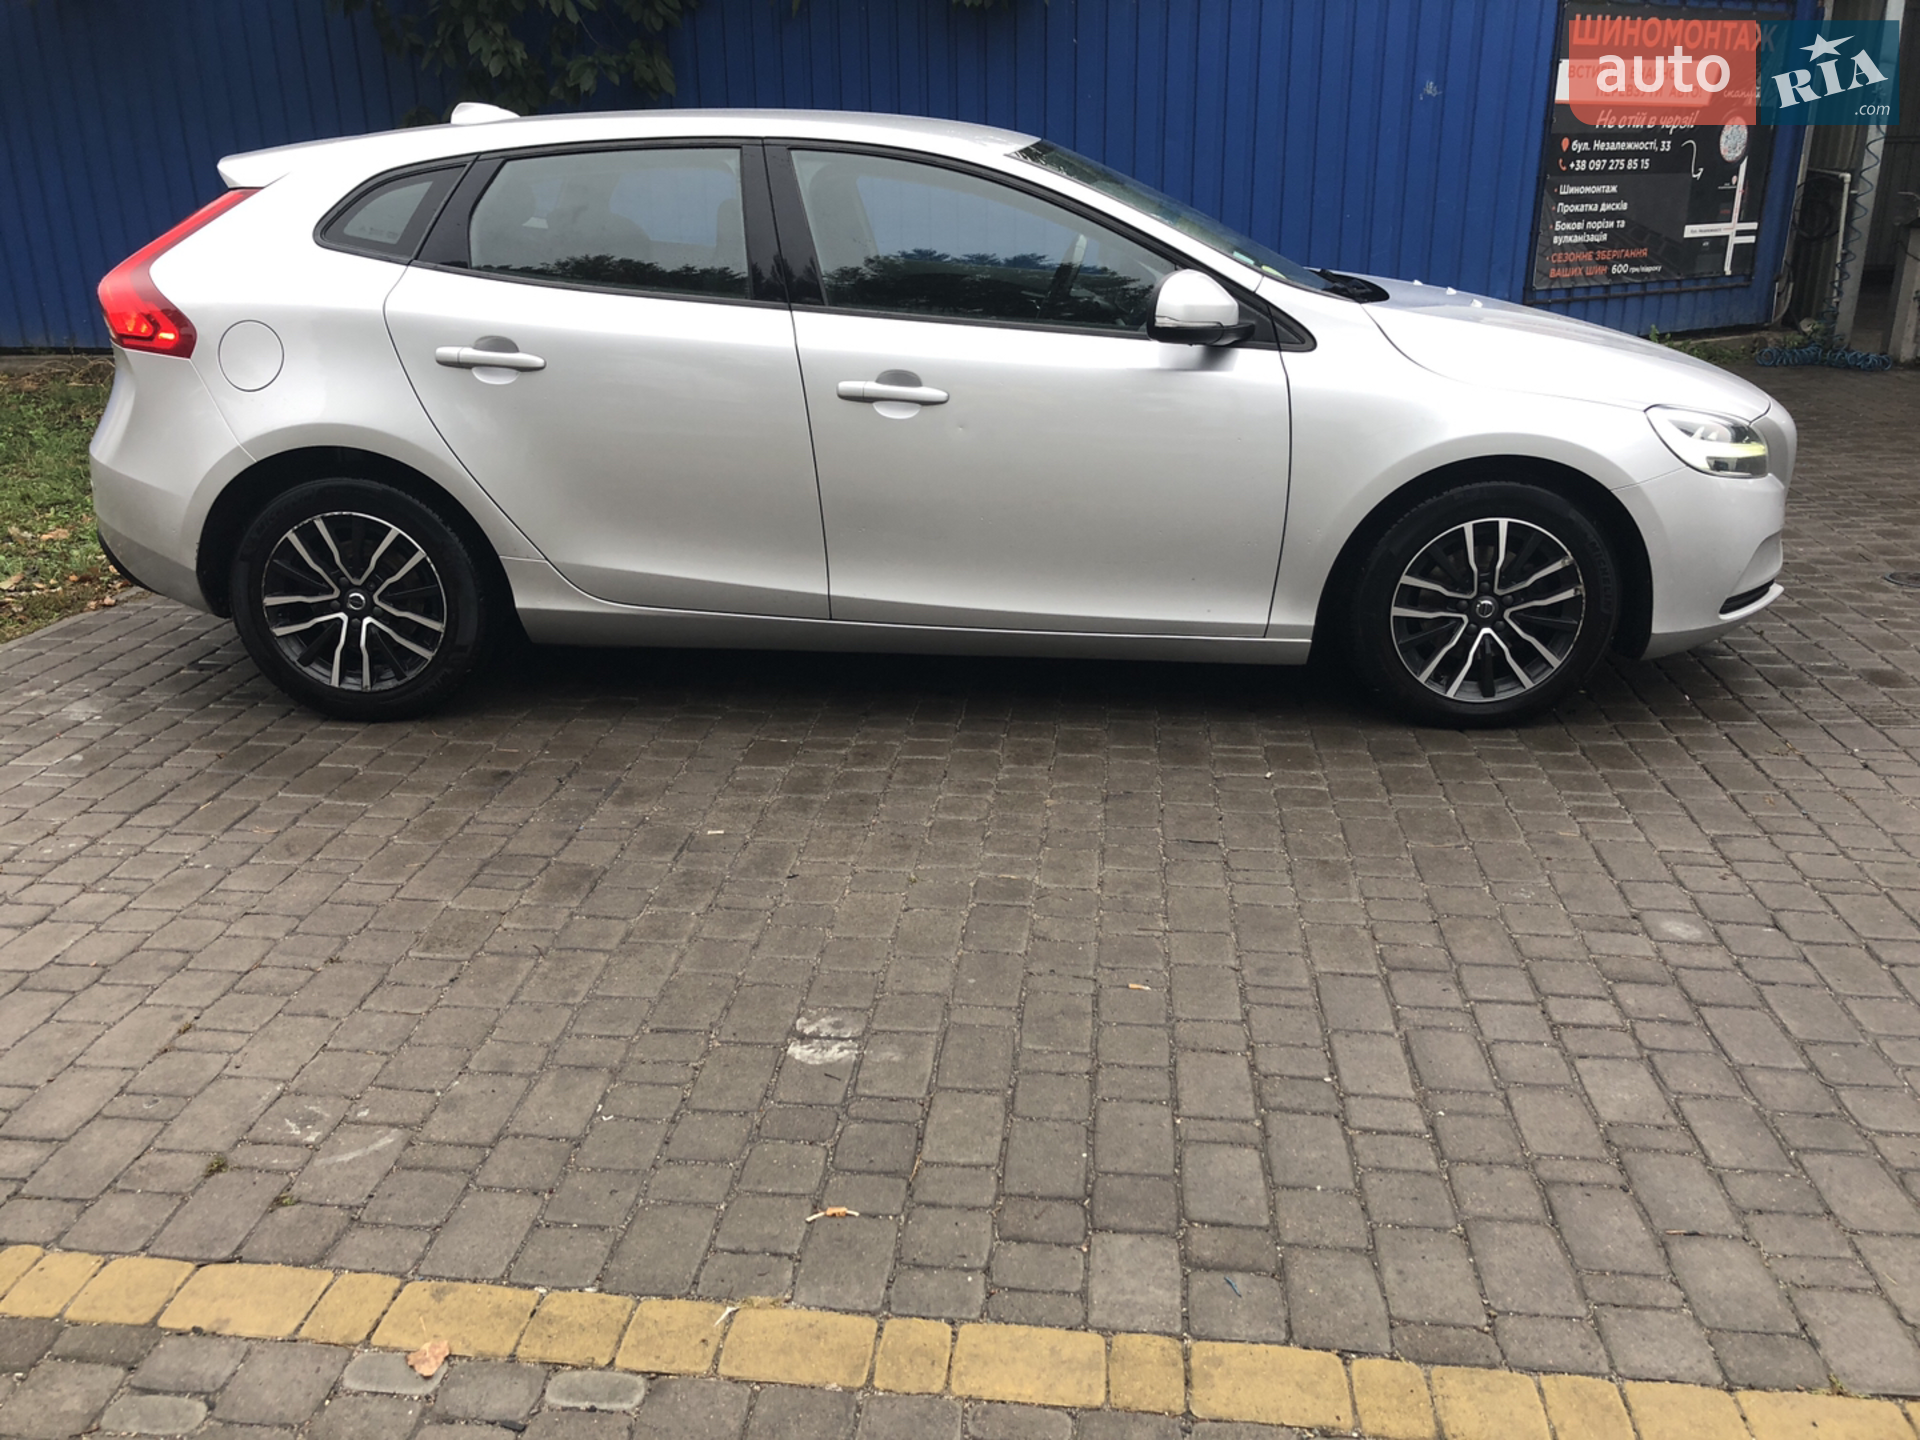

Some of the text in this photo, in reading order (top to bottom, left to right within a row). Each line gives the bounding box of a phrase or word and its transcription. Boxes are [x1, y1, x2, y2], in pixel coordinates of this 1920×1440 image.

[1572, 14, 1777, 52] ШИНОМОНТАЖ
[1595, 109, 1616, 129] Не
[1647, 115, 1657, 129] в
[1571, 138, 1671, 152] бул. Незалежності, 33
[1569, 158, 1650, 171] +38 097 275 85 15
[1559, 184, 1618, 195] Шиномонтаж
[1557, 200, 1628, 214] Прокатка дисків
[1555, 220, 1626, 232] Бокові порізи та
[1553, 231, 1608, 245] вулканізація
[1551, 247, 1648, 264] СЕЗОННЕ ЗБЕРІГАННЯ
[1549, 266, 1584, 279] ВАШИХ
[1585, 265, 1608, 277] ШИН
[1611, 264, 1629, 275] 600
